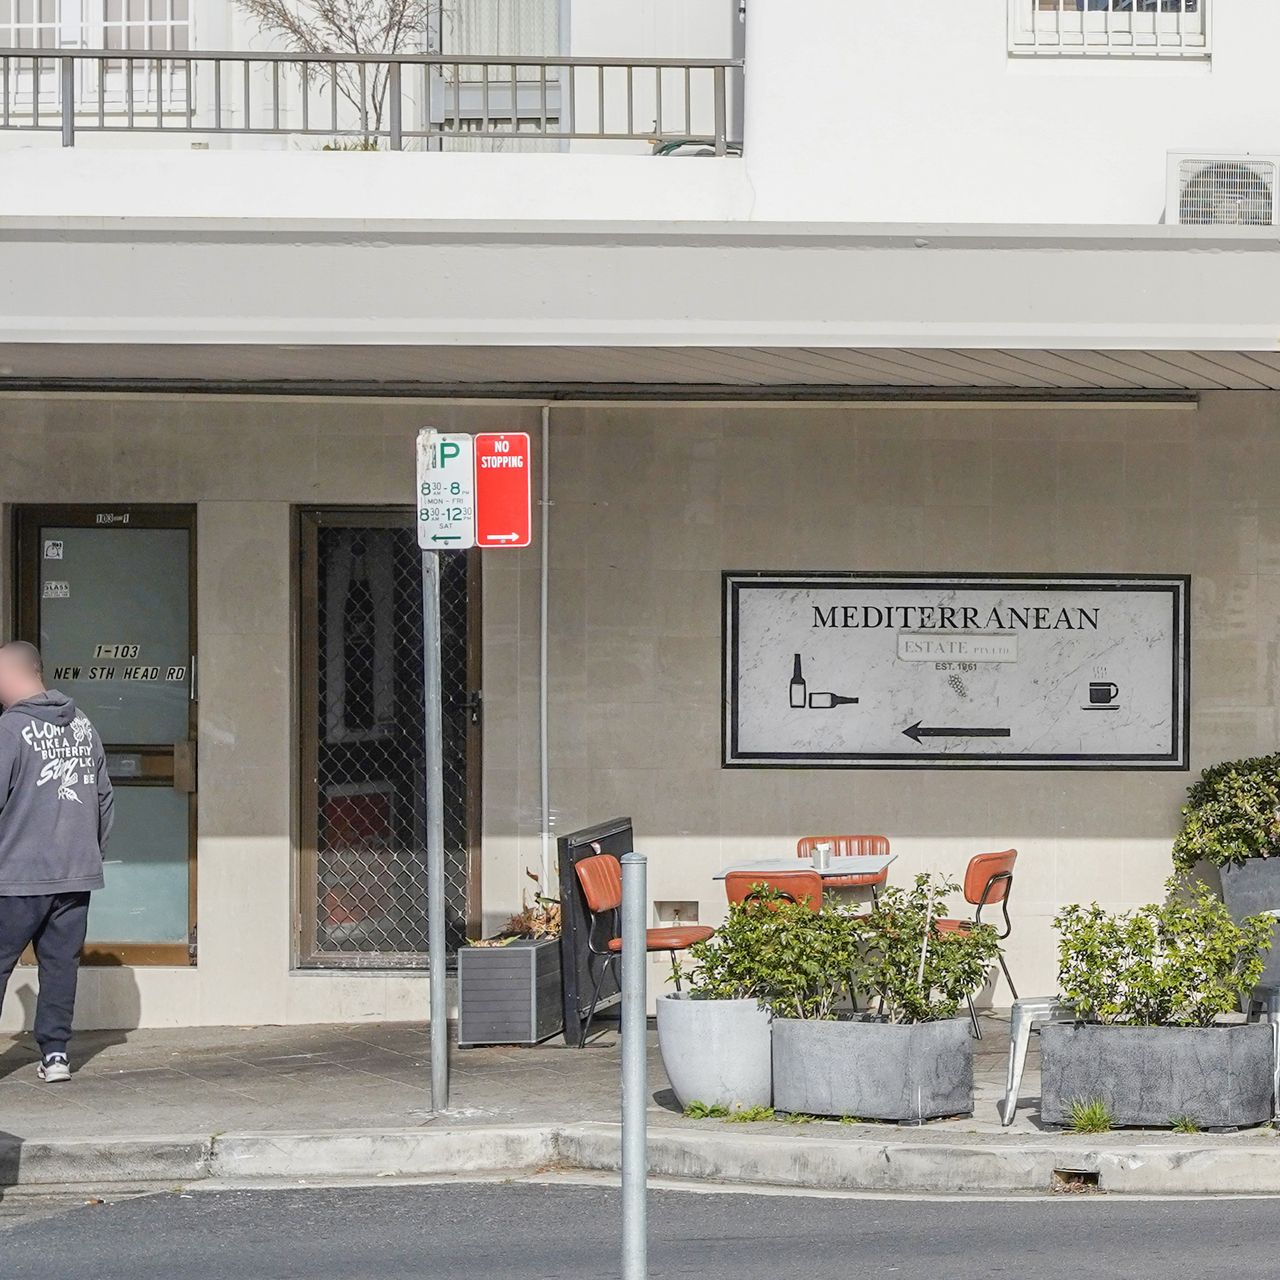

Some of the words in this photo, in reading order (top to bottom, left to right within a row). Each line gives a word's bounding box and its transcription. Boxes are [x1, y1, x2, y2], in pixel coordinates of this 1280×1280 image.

[494, 440, 510, 453] NO
[481, 456, 524, 468] STOPPING
[812, 605, 1100, 630] MEDITERRANEAN
[96, 645, 139, 658] 1-103
[905, 641, 968, 654] ESTATE
[935, 662, 955, 671] EST.
[54, 667, 81, 680] NEW
[89, 667, 115, 680] STH
[124, 667, 159, 680] HEAD
[167, 667, 185, 680] RD
[33, 738, 60, 752] LIKE
[62, 737, 69, 747] A
[41, 745, 92, 760] BUTTERFLY
